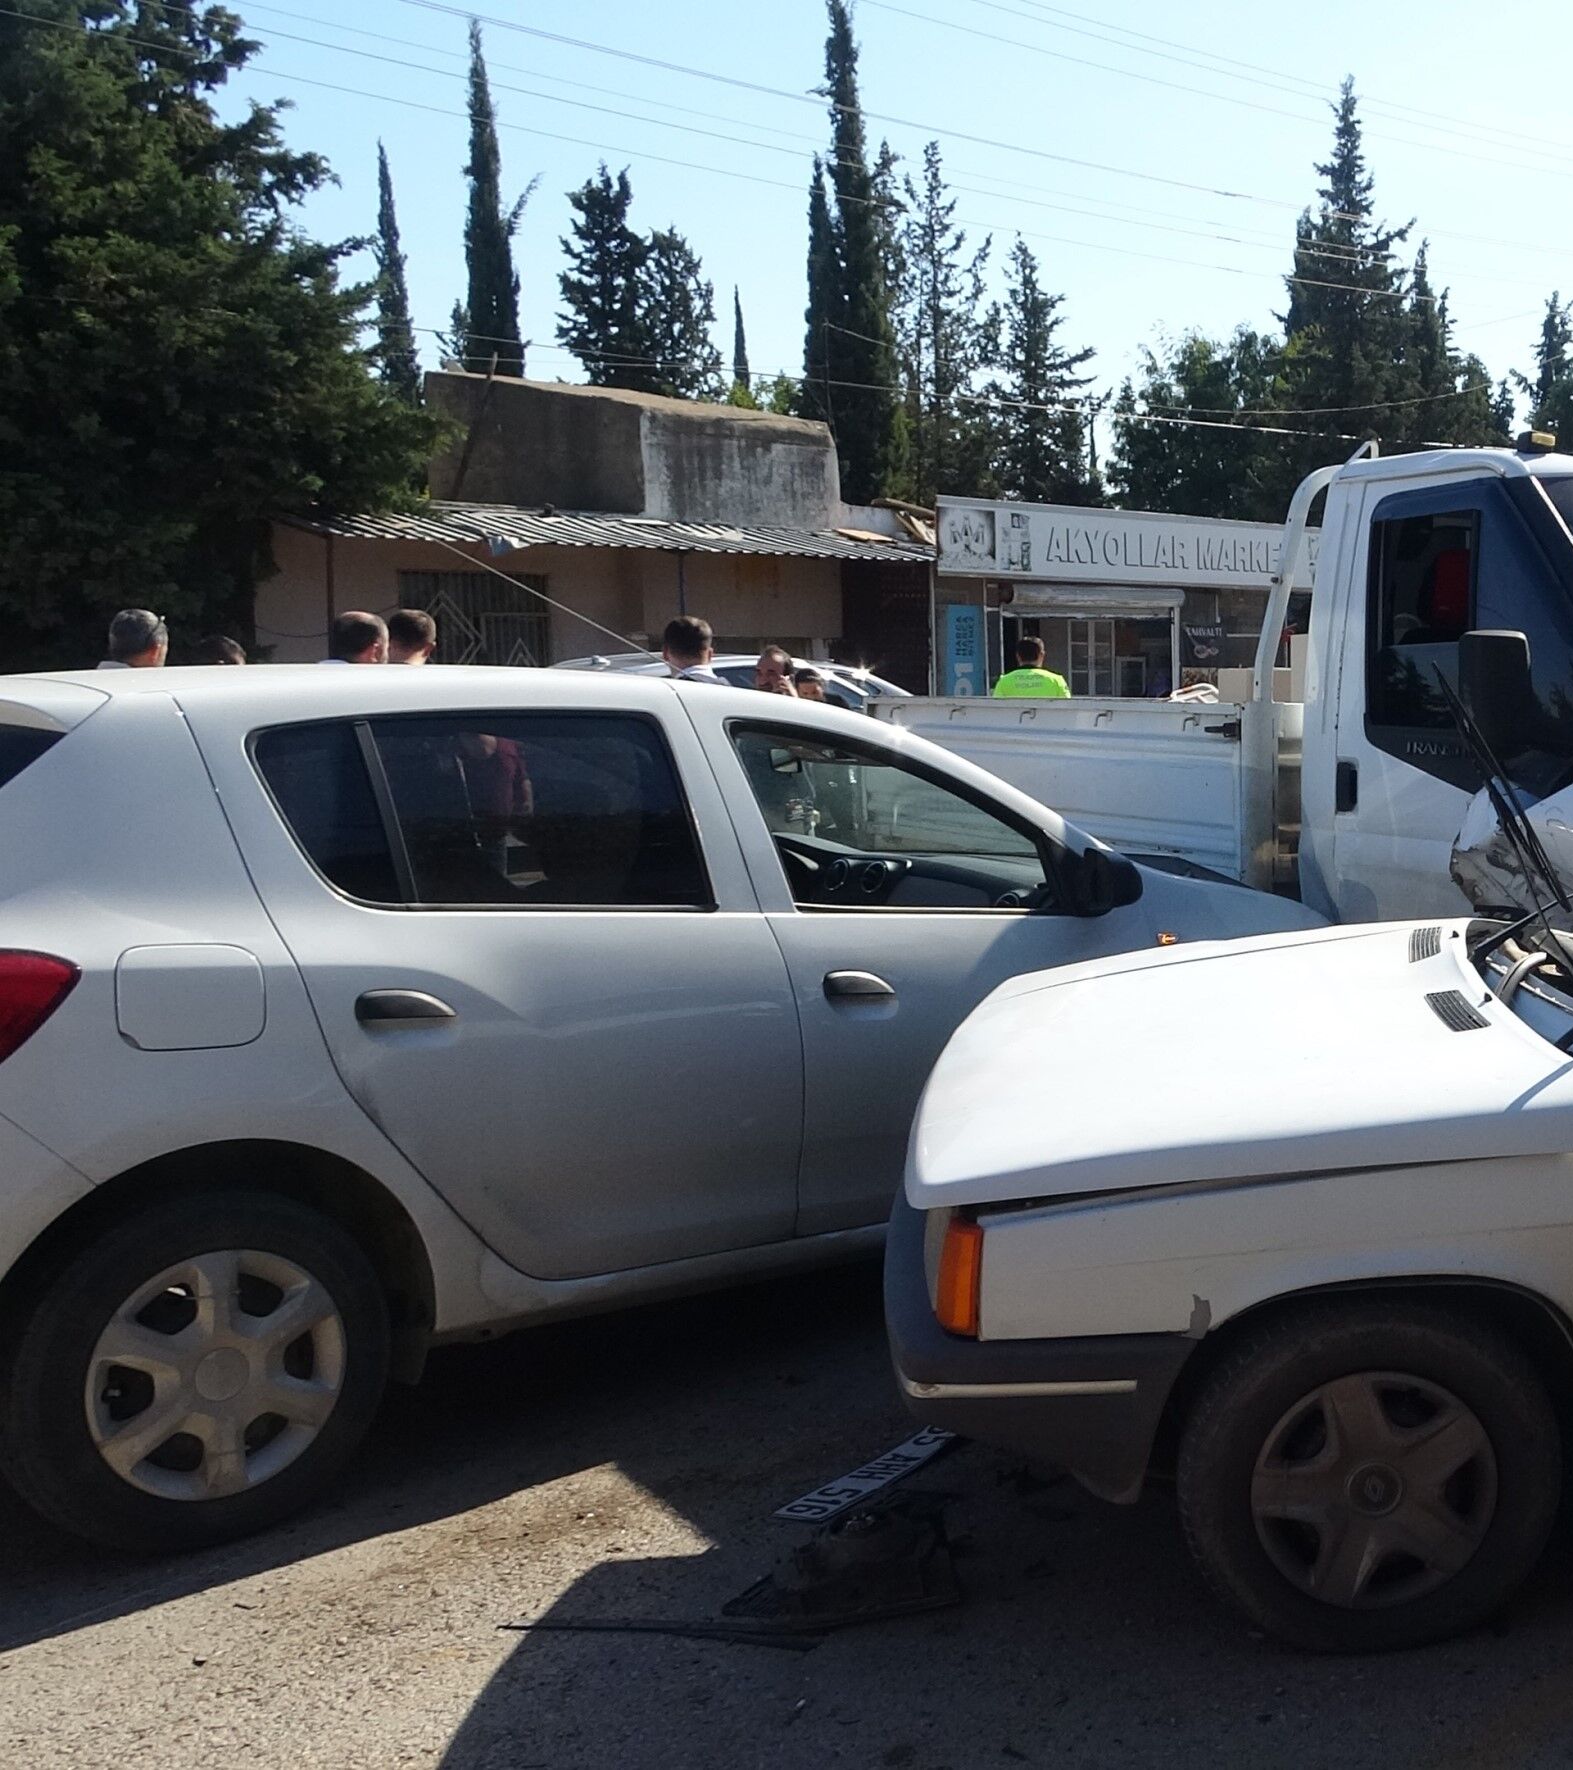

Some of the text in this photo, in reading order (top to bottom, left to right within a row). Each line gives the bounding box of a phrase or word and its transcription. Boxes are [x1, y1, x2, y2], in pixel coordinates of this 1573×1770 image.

[1046, 526, 1285, 575] AKYOLLAR MARKE
[785, 1486, 862, 1516] 516
